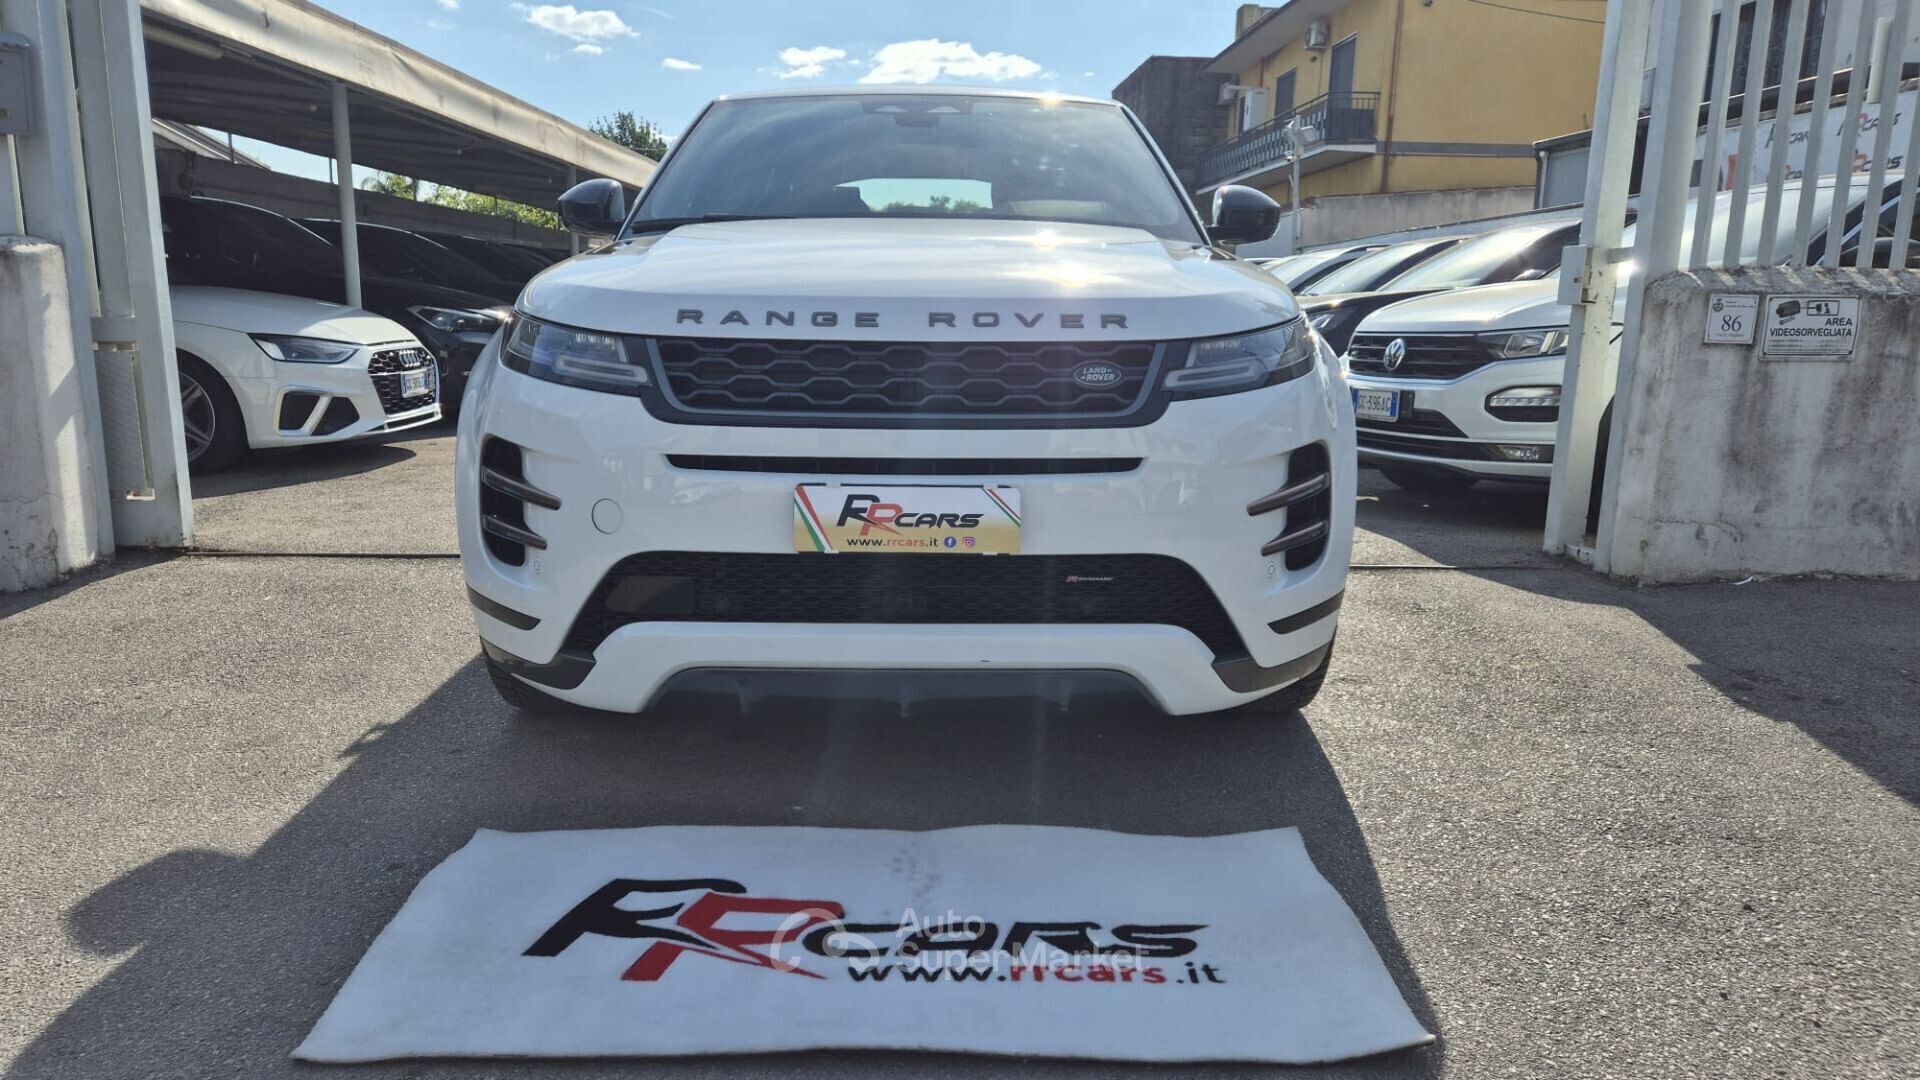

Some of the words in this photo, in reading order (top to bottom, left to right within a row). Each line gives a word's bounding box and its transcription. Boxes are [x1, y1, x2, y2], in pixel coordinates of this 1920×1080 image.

[676, 309, 880, 328] RANGE
[928, 312, 1129, 329] ROVER
[1721, 314, 1743, 332] 86
[1825, 317, 1853, 326] AREA
[1769, 327, 1852, 337] VIDEOSORVEGLIATA
[847, 537, 938, 548] www.rrcars.it
[847, 961, 1225, 984] www.rrcars.it
